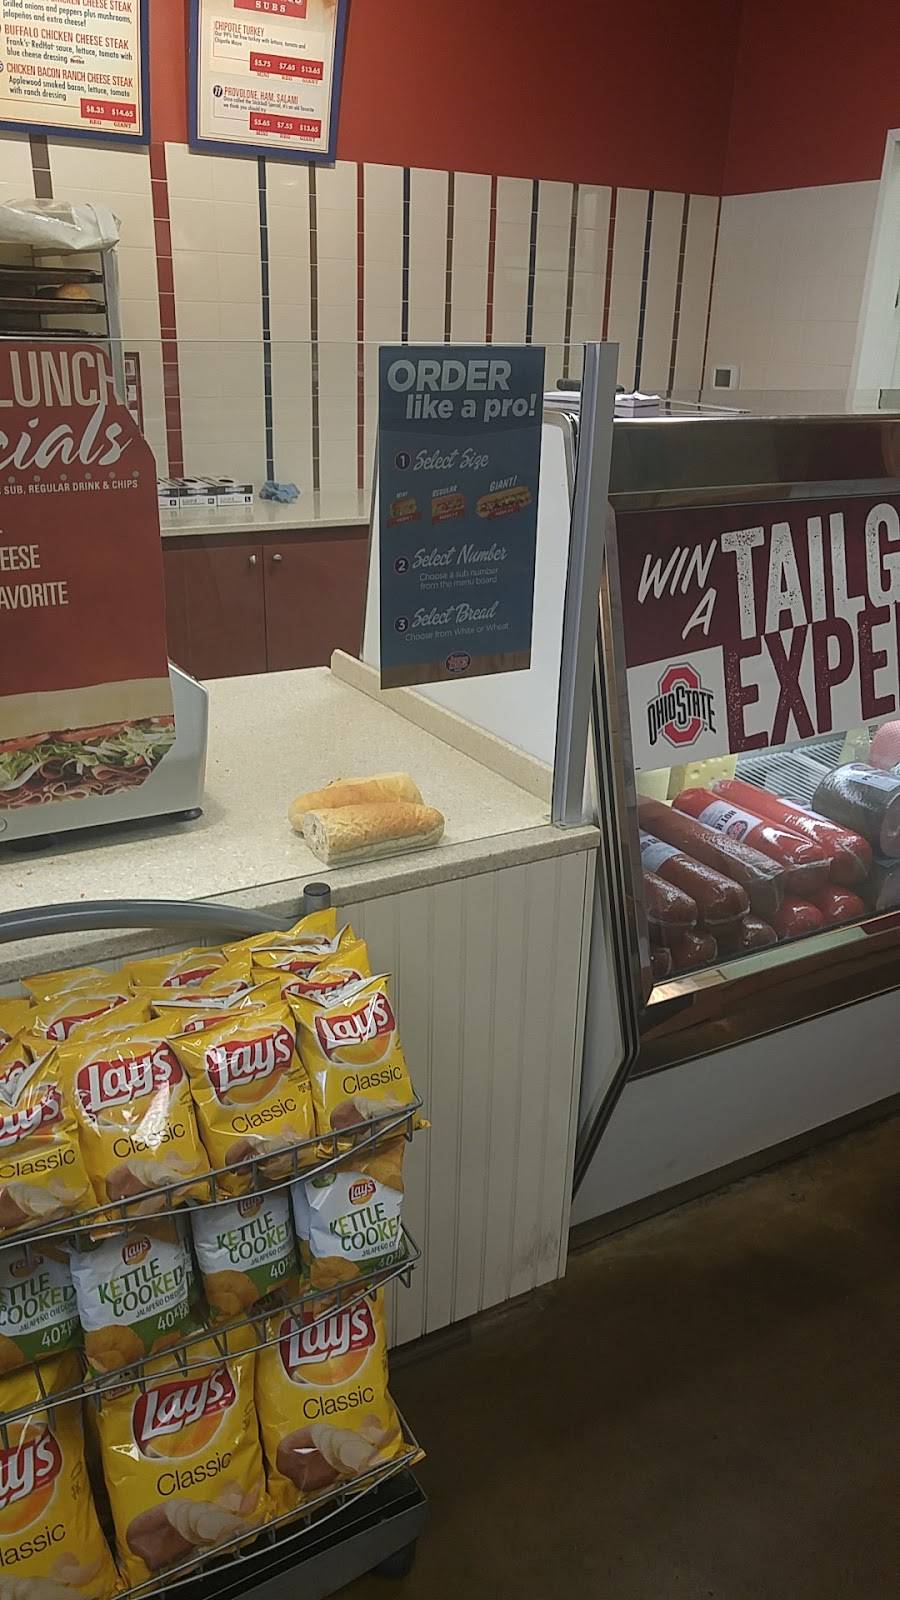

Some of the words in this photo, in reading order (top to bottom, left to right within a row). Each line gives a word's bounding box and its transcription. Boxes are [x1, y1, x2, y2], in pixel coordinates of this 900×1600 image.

[3, 0, 23, 8] Grilled
[25, 3, 44, 11] onions
[46, 4, 57, 12] and
[59, 7, 82, 16] peppers
[84, 9, 96, 18] plus
[98, 12, 132, 24] mushrooms,
[34, 14, 45, 22] and
[47, 16, 62, 24] extra
[110, 1, 132, 12] STEAK
[256, 1, 286, 12] SUBS
[4, 24, 39, 38] BUFFALO
[41, 28, 73, 42] CHICKEN
[76, 33, 103, 46] CHEESE
[105, 37, 129, 50] STEAK
[215, 21, 241, 33] CHIPOTLE
[244, 25, 264, 37] TURKEY
[7, 47, 20, 56] blue
[22, 49, 42, 59] cheese
[43, 52, 68, 64] dressing
[56, 45, 74, 54] sauce,
[76, 45, 97, 57] lettuce,
[99, 49, 119, 59] tomato
[120, 52, 132, 60] with
[7, 63, 35, 76] CHICKEN
[37, 66, 60, 78] BACON
[63, 69, 85, 82] RANCH
[87, 73, 110, 84] CHEESE
[113, 76, 133, 87] STEAK
[9, 75, 41, 87] Applewood
[43, 80, 65, 89] smoked
[68, 83, 86, 93] bacon,
[88, 85, 108, 96] lettuce,
[110, 88, 130, 97] tomato
[24, 88, 40, 97] ranch
[42, 90, 66, 101] dressing
[0, 351, 126, 407] UNCH
[387, 360, 512, 392] ORDER
[406, 393, 453, 420] like
[461, 399, 476, 418] a
[484, 393, 536, 422] pro!
[413, 449, 460, 471] Select
[460, 448, 489, 471] Size
[4, 486, 26, 495] SUB,
[28, 483, 70, 493] REGULAR
[73, 482, 100, 491] DRINK
[103, 481, 109, 489] &
[112, 479, 138, 489] CHIPS
[490, 475, 518, 492] GIANT!
[399, 560, 406, 571] 2
[412, 546, 456, 569] Select
[457, 542, 507, 564] Number
[720, 502, 900, 640] TAILG
[421, 582, 438, 590] from
[638, 539, 717, 604] WIN
[399, 620, 406, 630] 3
[412, 606, 454, 628] Select
[456, 600, 499, 622] Bread
[682, 588, 717, 640] A
[722, 602, 900, 755] EXPE
[342, 1065, 403, 1094] Classic
[232, 1097, 297, 1134] Classic
[113, 1122, 185, 1158] Classic
[0, 1149, 75, 1179] Classic
[217, 1211, 275, 1249] KETTLE
[330, 1202, 387, 1238] KETTLE
[342, 1215, 400, 1251] COOKE
[98, 1258, 162, 1304] KETTLE
[113, 1265, 184, 1317] COOKED
[303, 1386, 374, 1420] Classic
[157, 1452, 232, 1496] Classic
